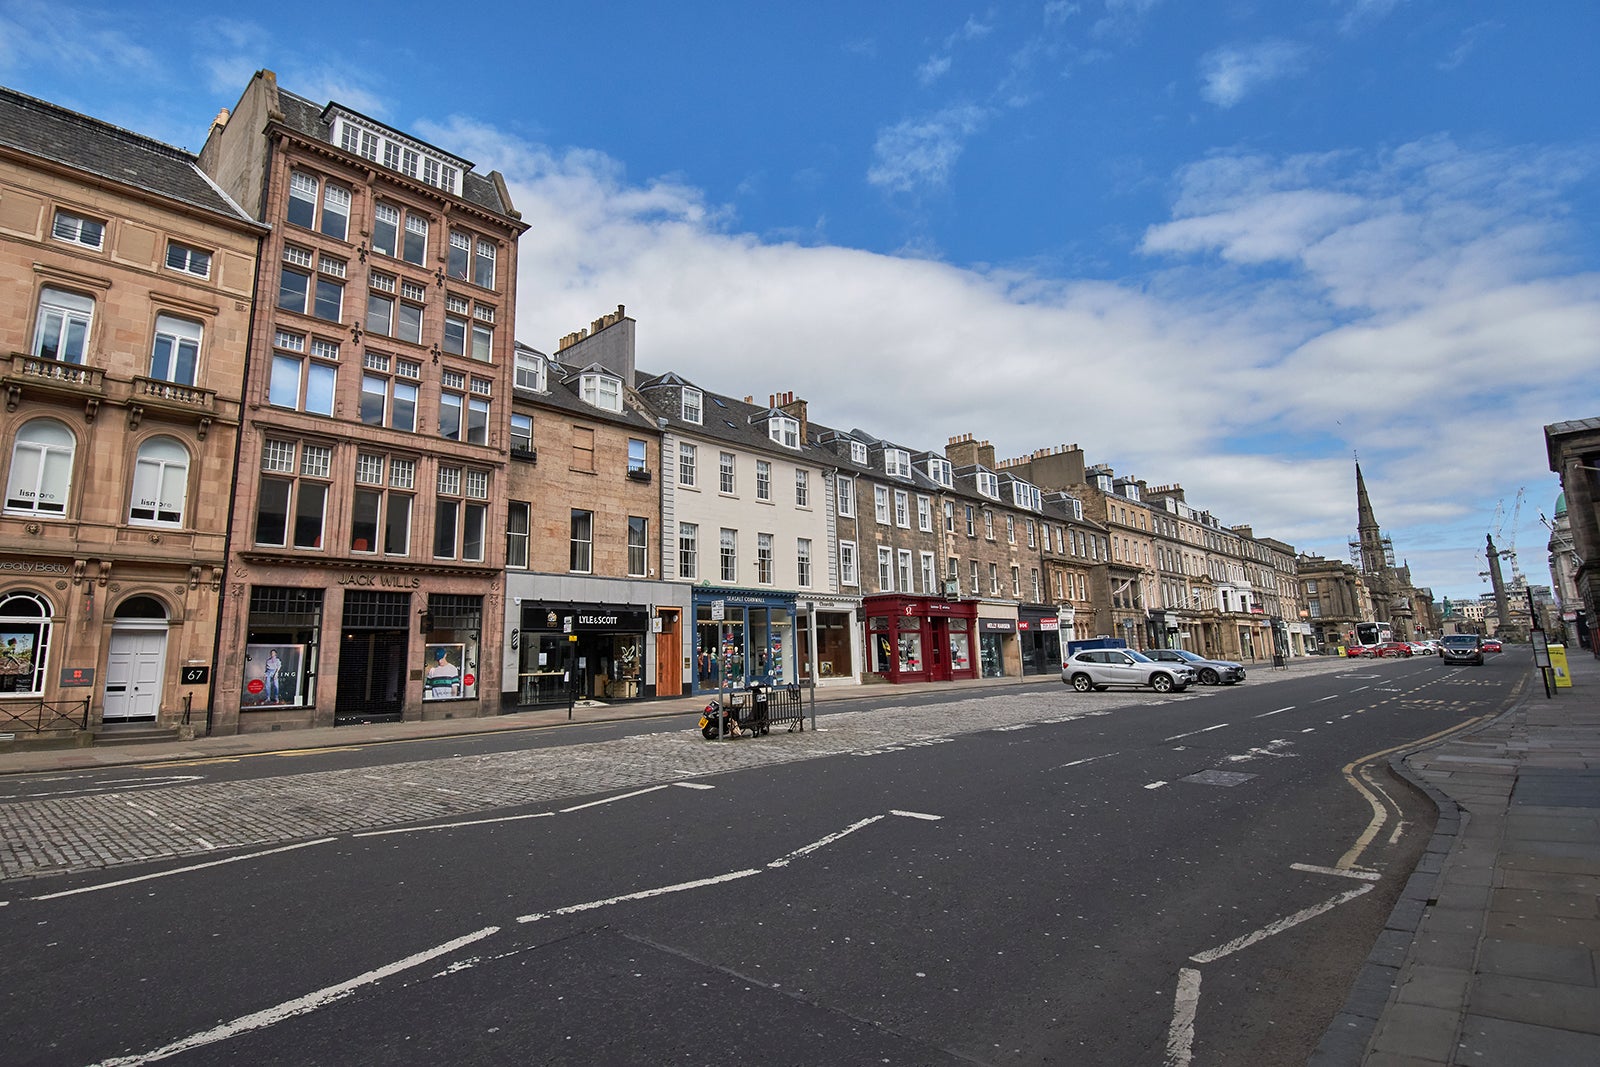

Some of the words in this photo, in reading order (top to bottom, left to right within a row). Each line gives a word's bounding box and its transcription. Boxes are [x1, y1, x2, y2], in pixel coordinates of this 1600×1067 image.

[35, 561, 69, 575] Betty
[338, 572, 376, 586] JACK
[380, 575, 421, 589] WILLS
[187, 670, 203, 680] 67
